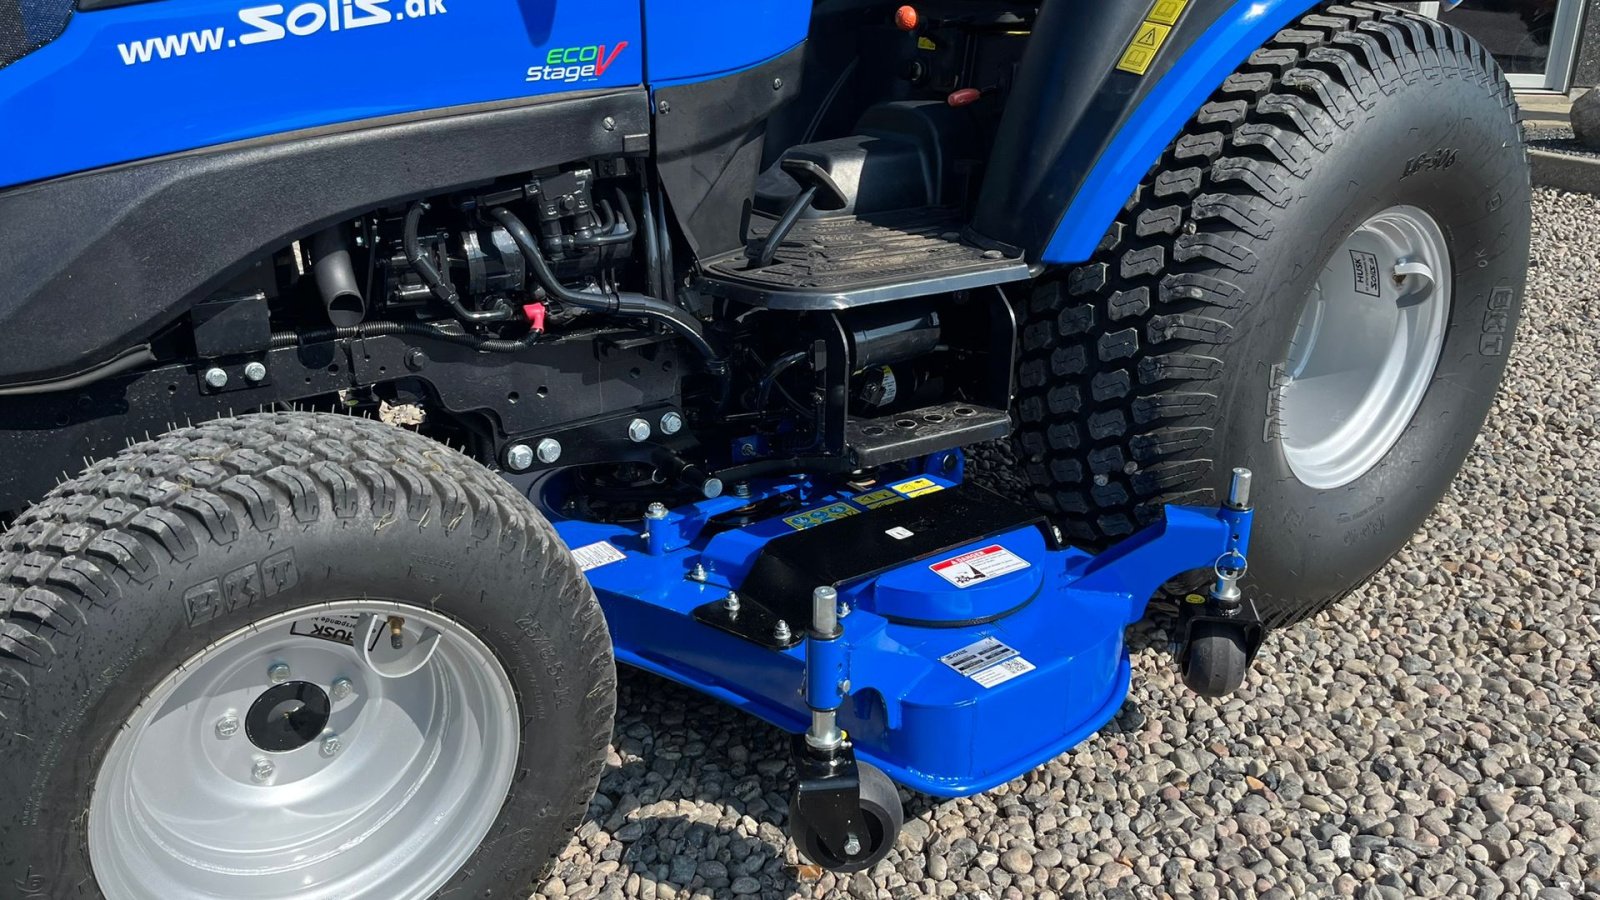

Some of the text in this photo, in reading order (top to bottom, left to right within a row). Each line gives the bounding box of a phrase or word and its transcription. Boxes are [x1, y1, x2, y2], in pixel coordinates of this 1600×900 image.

[525, 41, 628, 82] Stage V
[1354, 258, 1364, 284] HUSK
